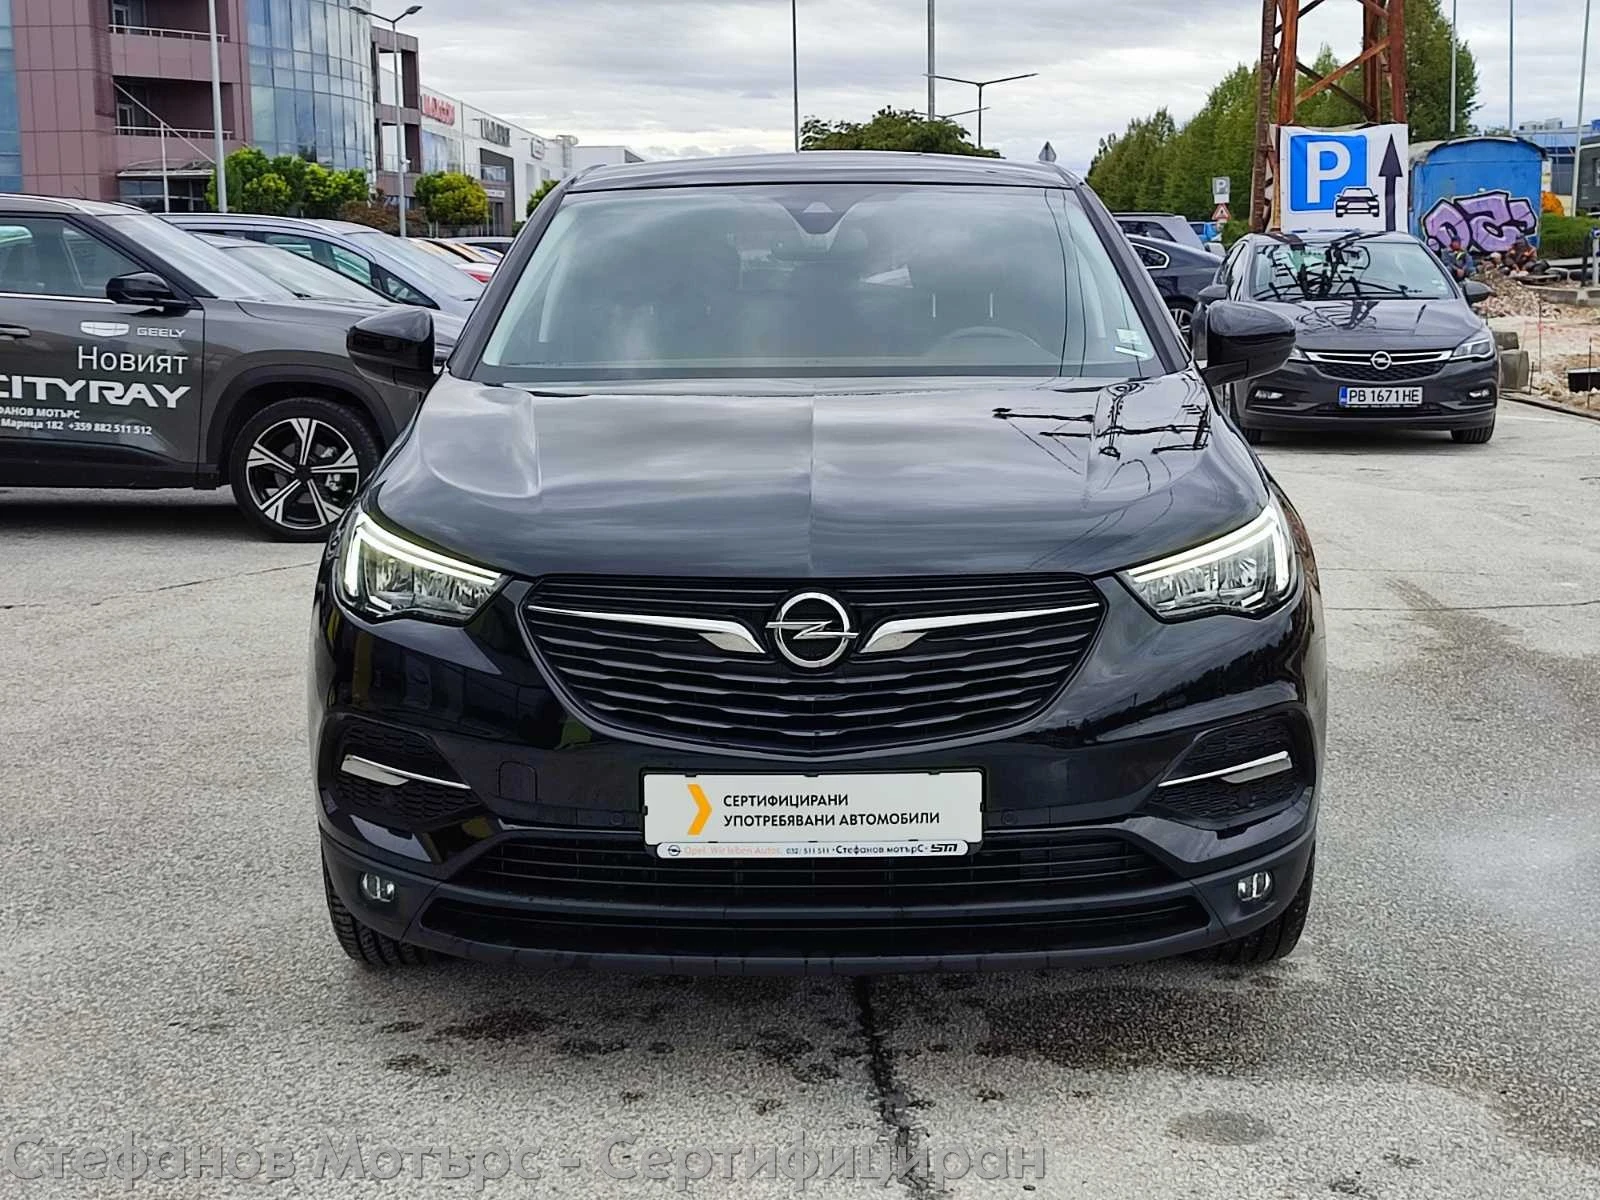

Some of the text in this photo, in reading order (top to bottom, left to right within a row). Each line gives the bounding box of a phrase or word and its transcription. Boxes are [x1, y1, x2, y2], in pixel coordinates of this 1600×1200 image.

[1306, 140, 1351, 204] P
[136, 327, 186, 337] GEELY
[77, 345, 189, 375] Новият
[1349, 389, 1420, 402] PB 1671 HE
[0, 418, 152, 436] Марица 182 +359 882 511 512
[723, 794, 848, 808] СЕРТИФИЦИРАНИ
[723, 812, 940, 827] УПОТРЕБЯВАНИ АВТОМОБИЛИ
